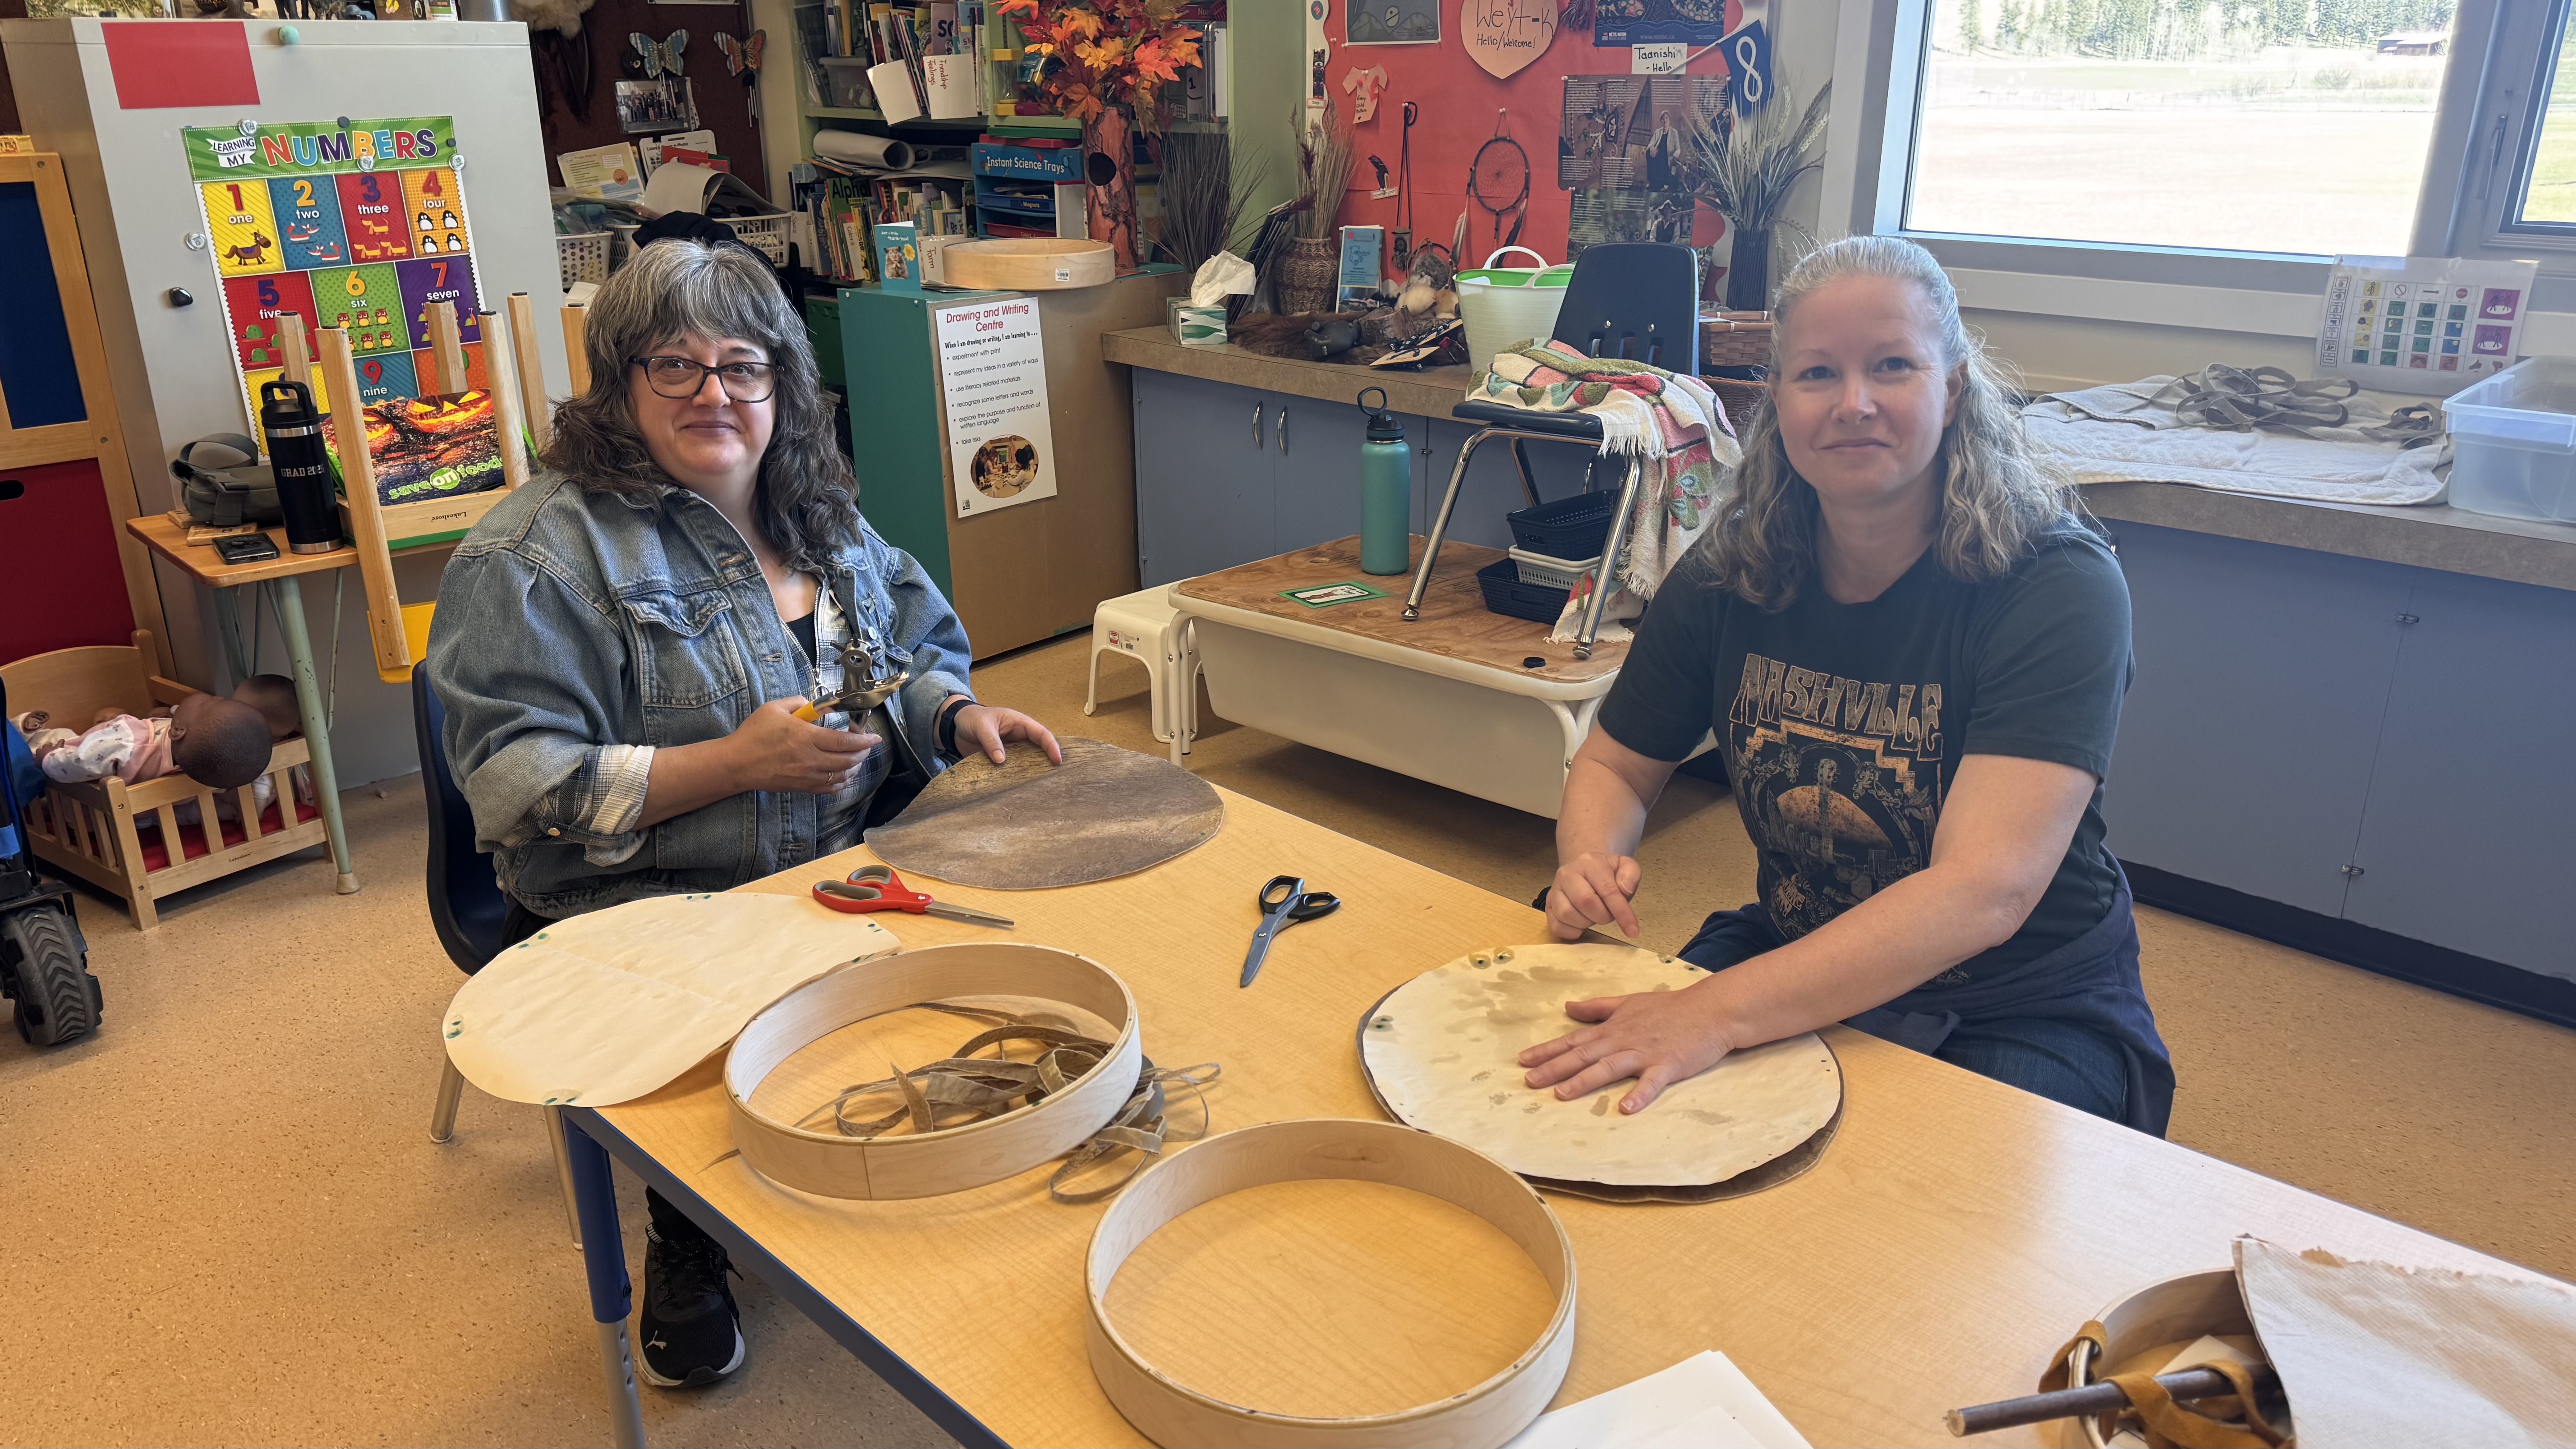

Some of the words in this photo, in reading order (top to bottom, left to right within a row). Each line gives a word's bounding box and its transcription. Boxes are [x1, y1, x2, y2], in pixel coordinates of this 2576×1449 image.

[1634, 47, 1675, 60] Taanishi
[927, 59, 936, 85] Feelings
[939, 59, 948, 89] Friendship
[213, 138, 255, 152] LEARNING
[261, 129, 437, 166] NUMBERS
[228, 153, 245, 166] MY
[987, 156, 1012, 167] Instant
[1014, 157, 1042, 170] Science
[1044, 160, 1064, 175] Trays
[361, 176, 380, 202] 3
[422, 171, 442, 196] 4
[226, 184, 243, 211] 1
[294, 180, 315, 207] 2
[358, 204, 389, 215] three
[423, 198, 446, 208] four
[228, 214, 253, 225] one
[296, 209, 320, 220] two
[431, 262, 447, 287] 7
[346, 271, 365, 296] 6
[258, 280, 279, 306] 5
[427, 289, 460, 300] seven
[351, 298, 367, 308] six
[259, 308, 281, 320] five
[947, 311, 980, 323] Drawing
[984, 307, 999, 318] and
[1002, 304, 1029, 315] Writing
[976, 320, 1003, 332] Centre
[967, 338, 981, 346] drawing
[952, 351, 979, 360] experiment
[363, 360, 382, 384] 9
[954, 367, 975, 377] represent
[363, 386, 388, 397] nine
[957, 399, 980, 407] recognize
[959, 414, 976, 423] explore
[1017, 403, 1035, 411] function
[976, 418, 999, 426] language
[281, 468, 306, 477] GRAD
[388, 481, 431, 500] save
[456, 455, 503, 478] food
[1729, 653, 1943, 761] NASHVILLE
